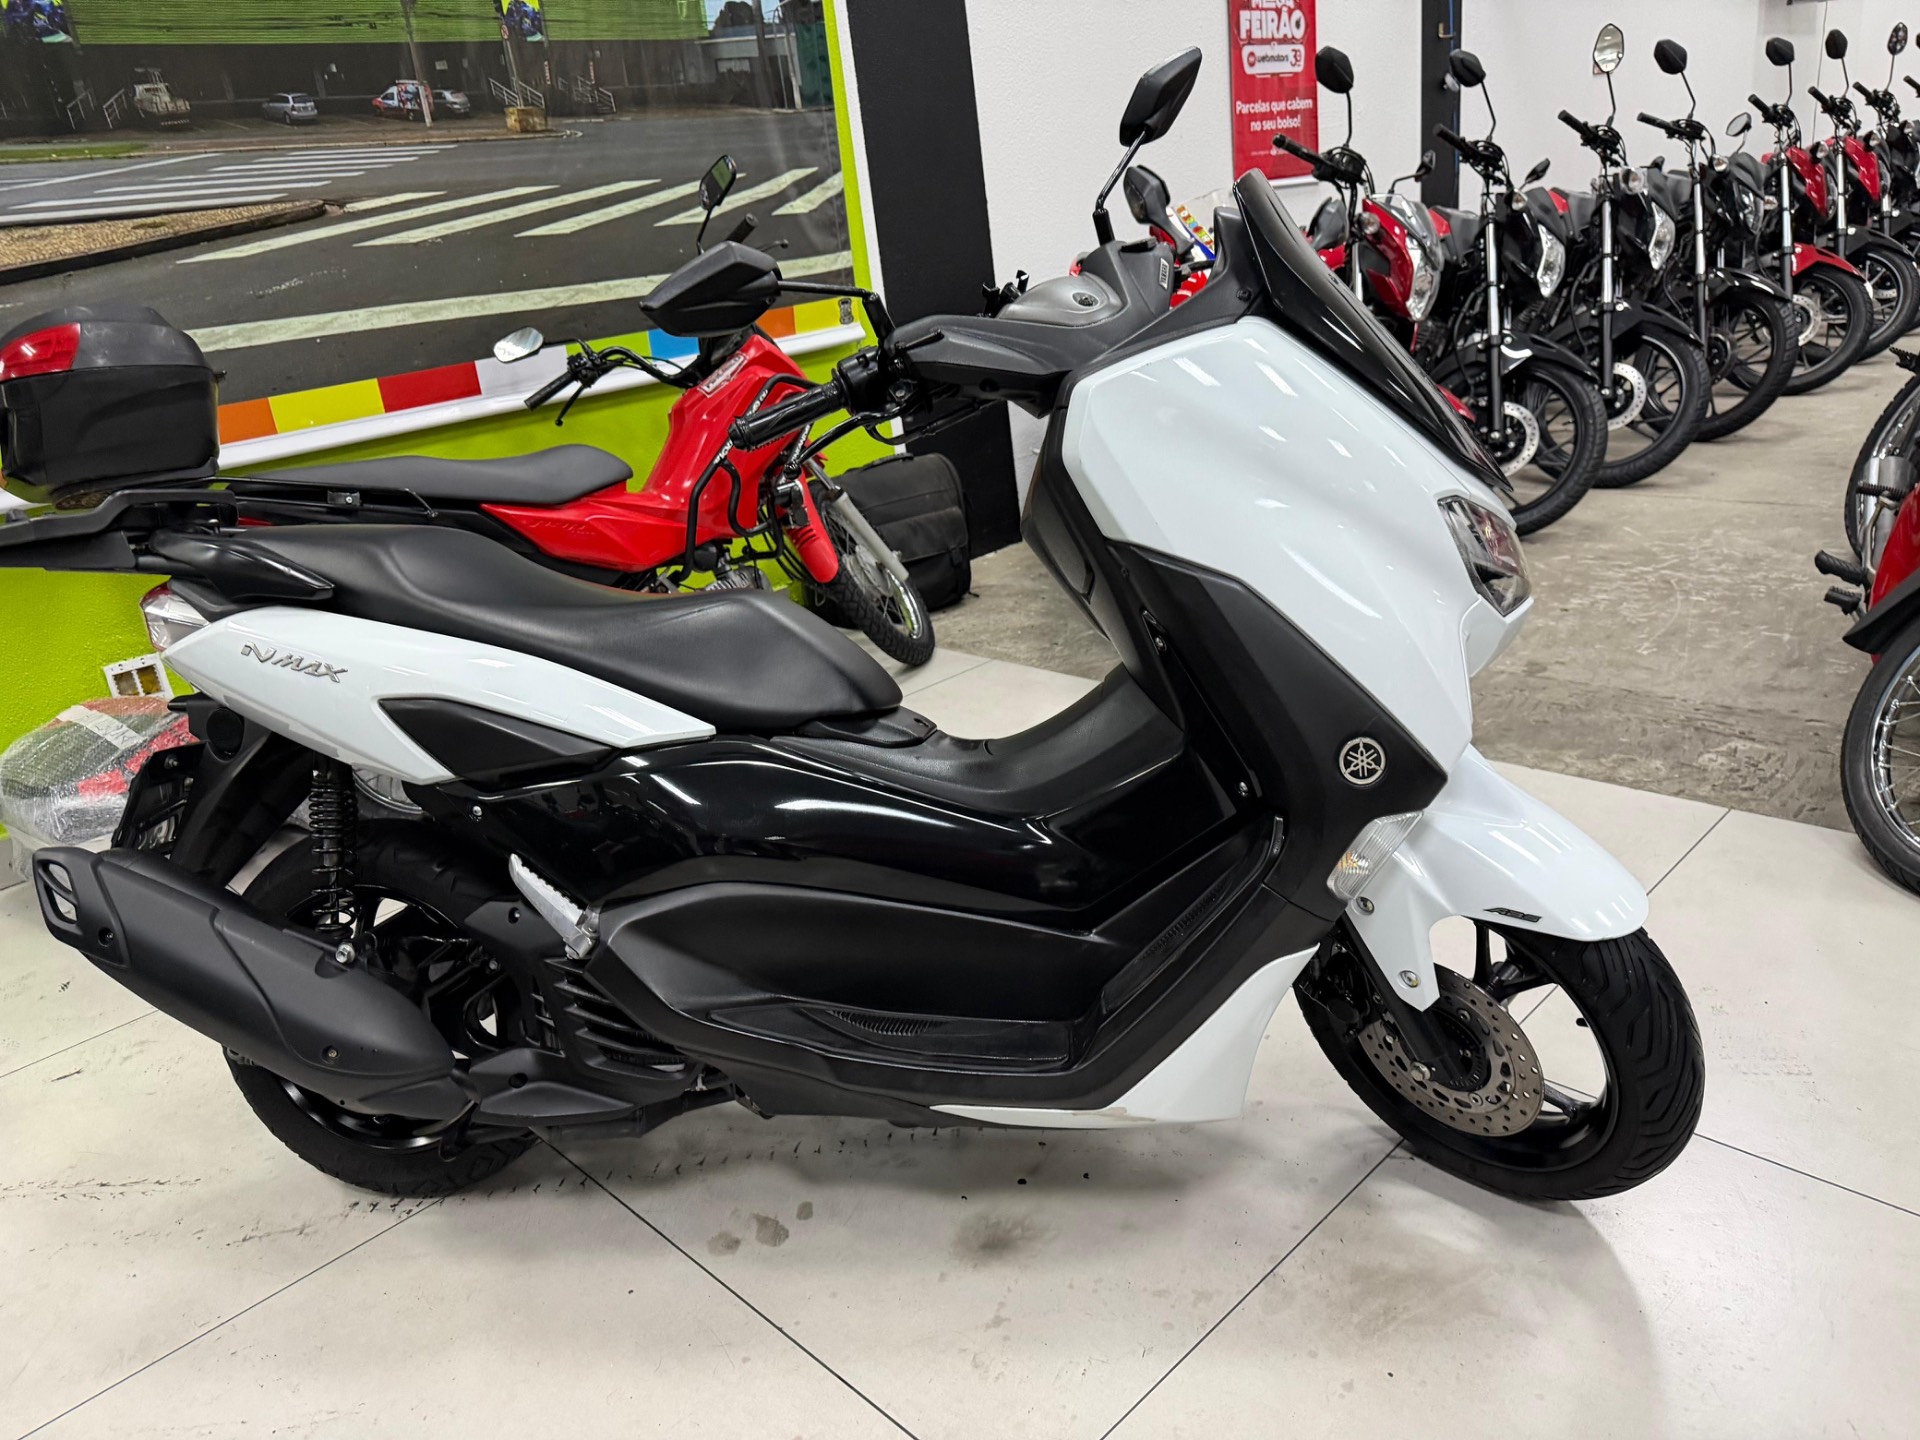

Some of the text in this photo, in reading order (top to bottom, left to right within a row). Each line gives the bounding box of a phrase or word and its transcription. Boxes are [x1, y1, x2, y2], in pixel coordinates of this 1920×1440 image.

[1240, 6, 1305, 39] FEIRÃO
[1236, 97, 1313, 114] Parcelas que cabem
[1250, 114, 1301, 132] no seu bolso!
